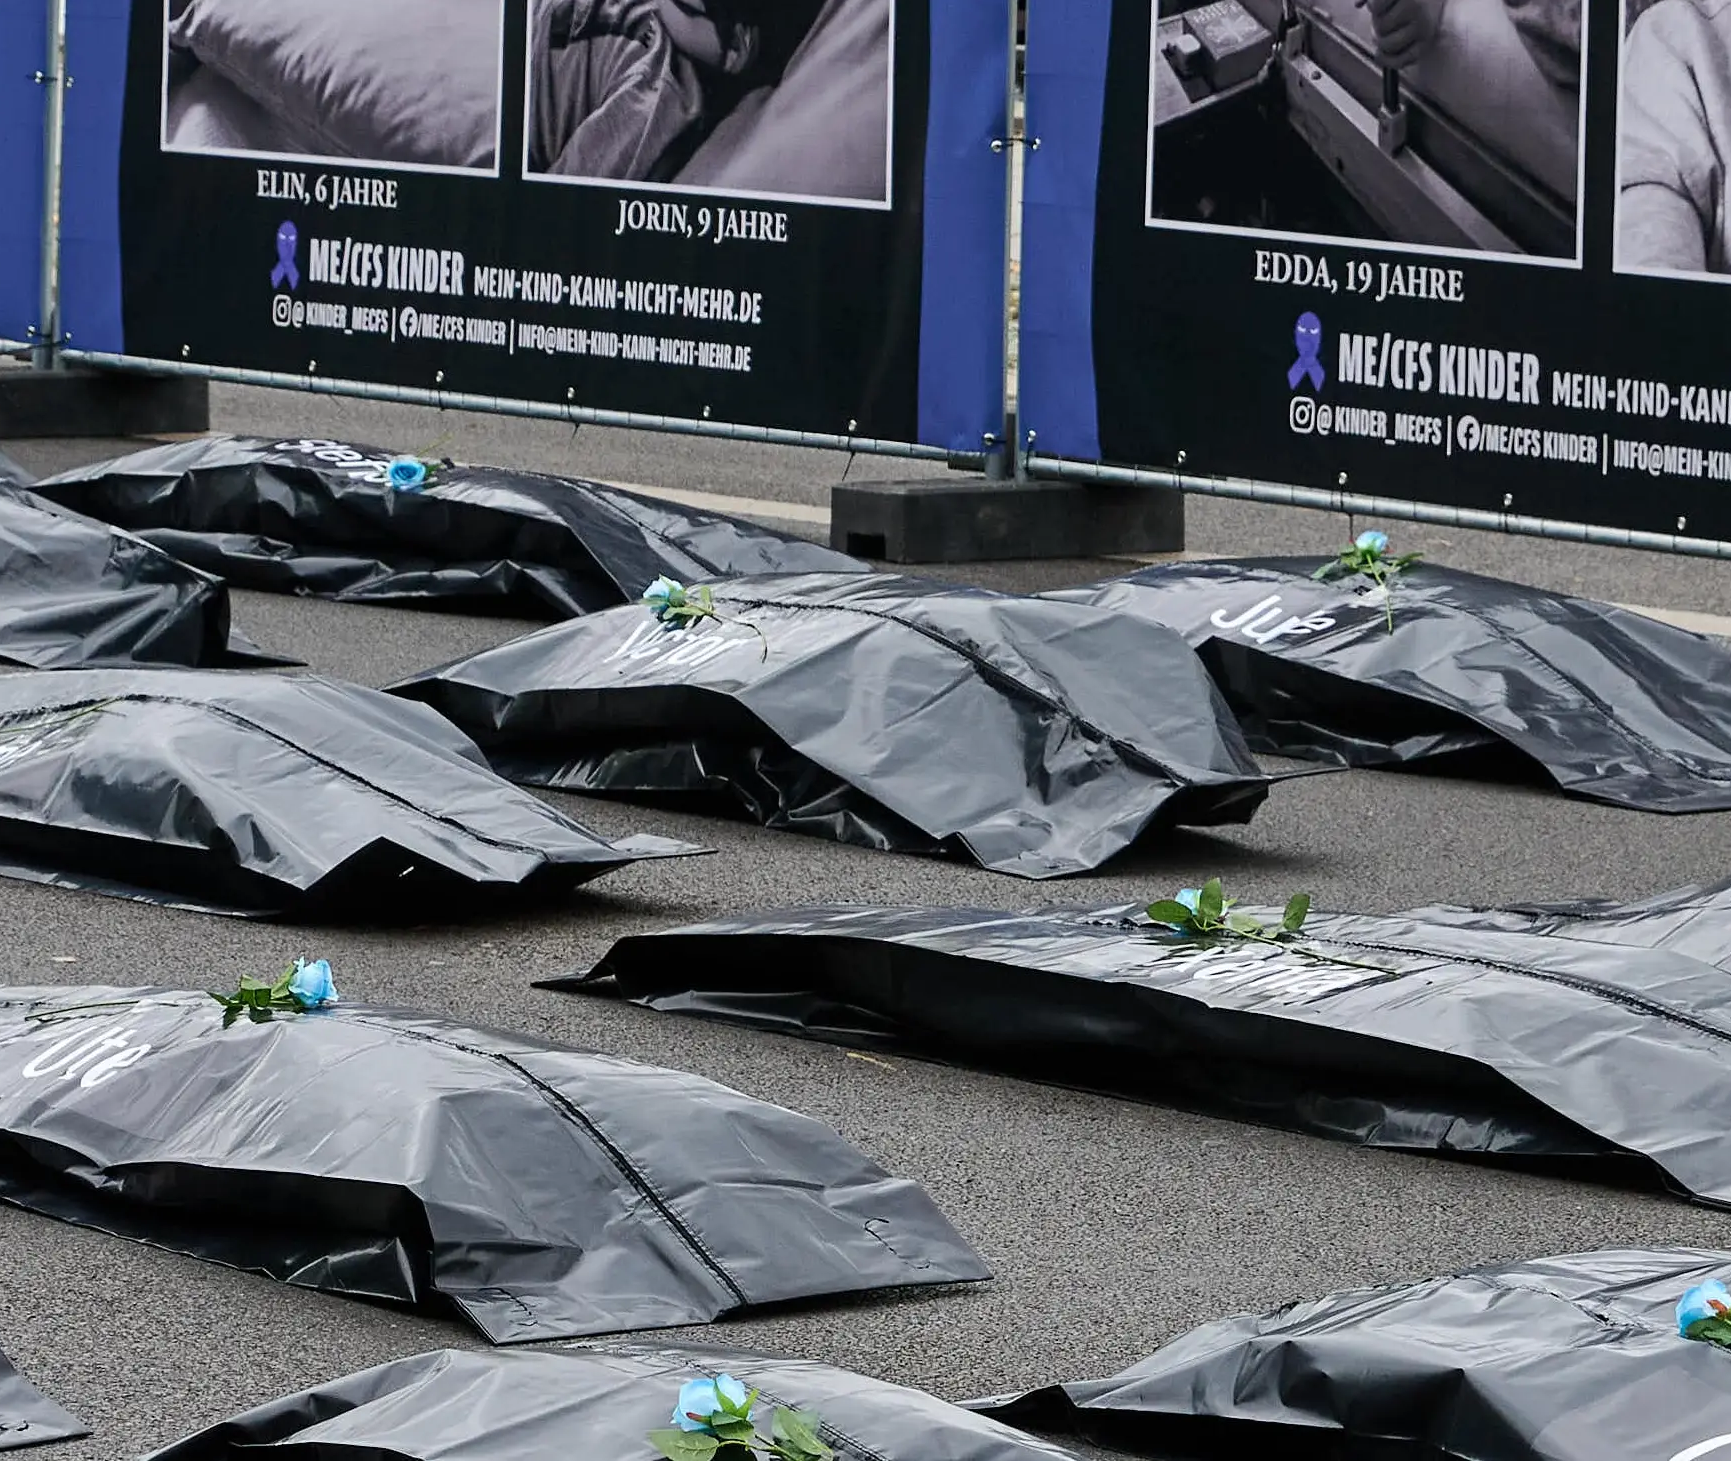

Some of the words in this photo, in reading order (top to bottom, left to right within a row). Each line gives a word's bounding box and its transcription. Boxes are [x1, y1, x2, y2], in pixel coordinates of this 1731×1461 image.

[256, 169, 310, 205] ELIN,
[315, 175, 327, 201] 6
[329, 176, 398, 210] JAHRE
[616, 199, 693, 237] JORIN,
[697, 208, 711, 237] 9
[714, 208, 788, 243] JAHRE
[309, 237, 383, 289] ME/CFS
[386, 243, 464, 297] KINDER
[474, 266, 762, 325] MEIN-KIND-KANN-NICHT-MEHR.DE
[1254, 250, 1340, 294] EDDA,
[1343, 261, 1373, 296] 19
[1375, 264, 1464, 303] JAHRE
[465, 318, 506, 346] KINDER
[518, 322, 751, 373] INFO@MEIN-KIND-KANN-NICHT-MEHR.DE
[1338, 331, 1432, 394] ME/CFS
[1439, 343, 1540, 406] KINDER
[1542, 430, 1597, 464] KINDER
[1210, 595, 1336, 645] Jue
[21, 1026, 151, 1088] Ute
